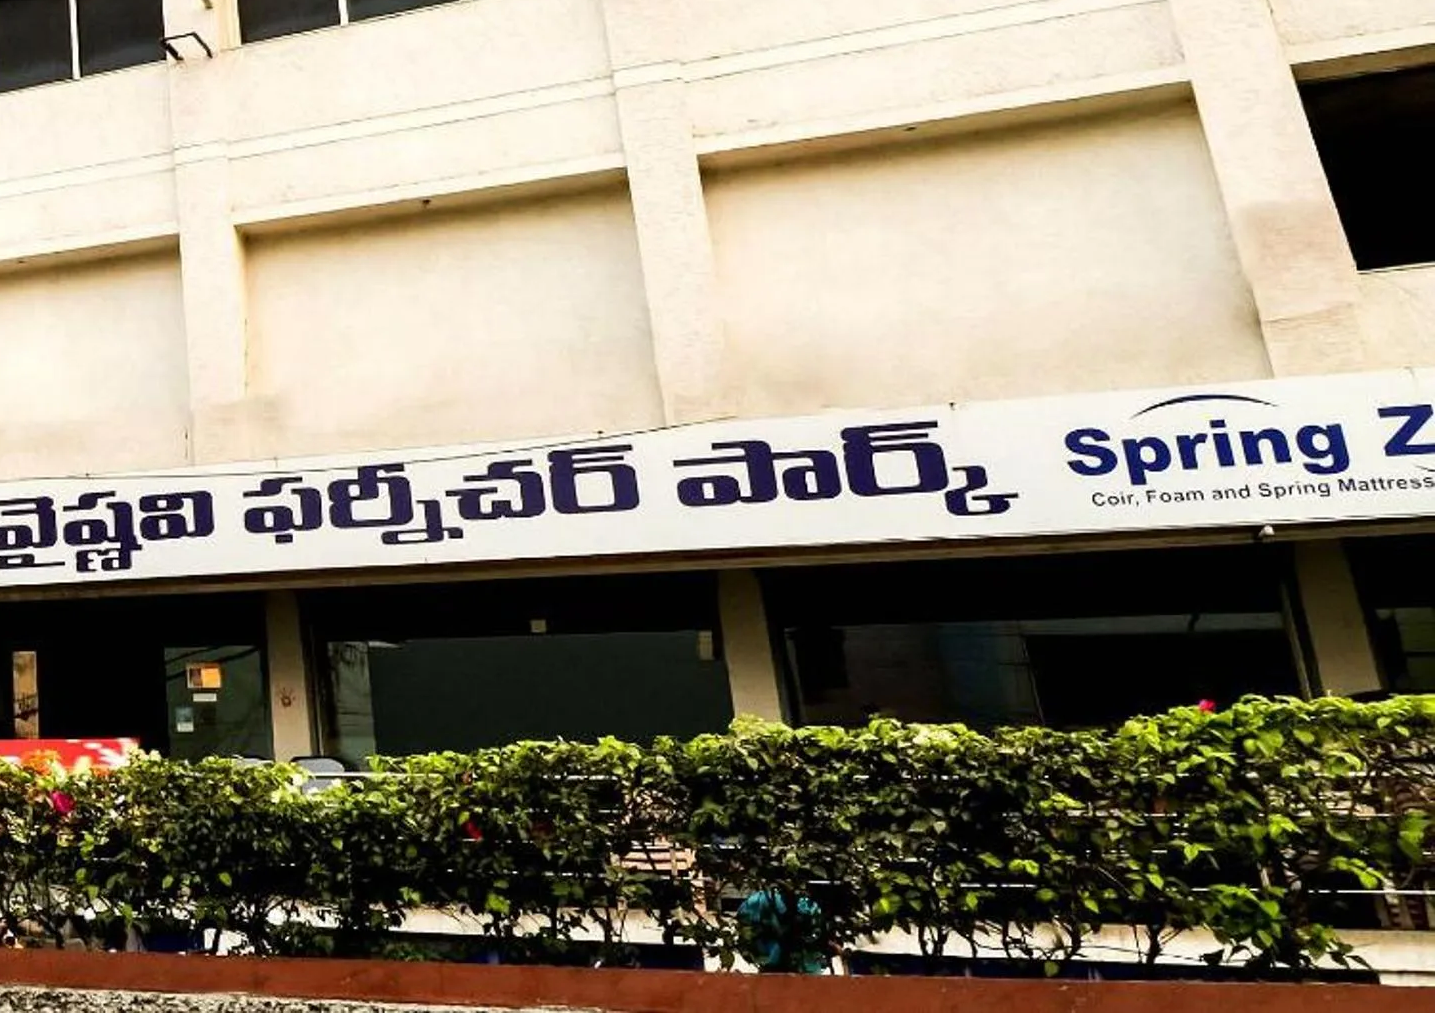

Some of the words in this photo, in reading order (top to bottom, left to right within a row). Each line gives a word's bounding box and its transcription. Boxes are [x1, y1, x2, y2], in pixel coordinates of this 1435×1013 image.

[1065, 418, 1349, 485] Spring
[1091, 491, 1140, 508] Coir,
[1146, 487, 1205, 504] Foam
[1212, 485, 1251, 501] and
[1258, 480, 1331, 499] Spring
